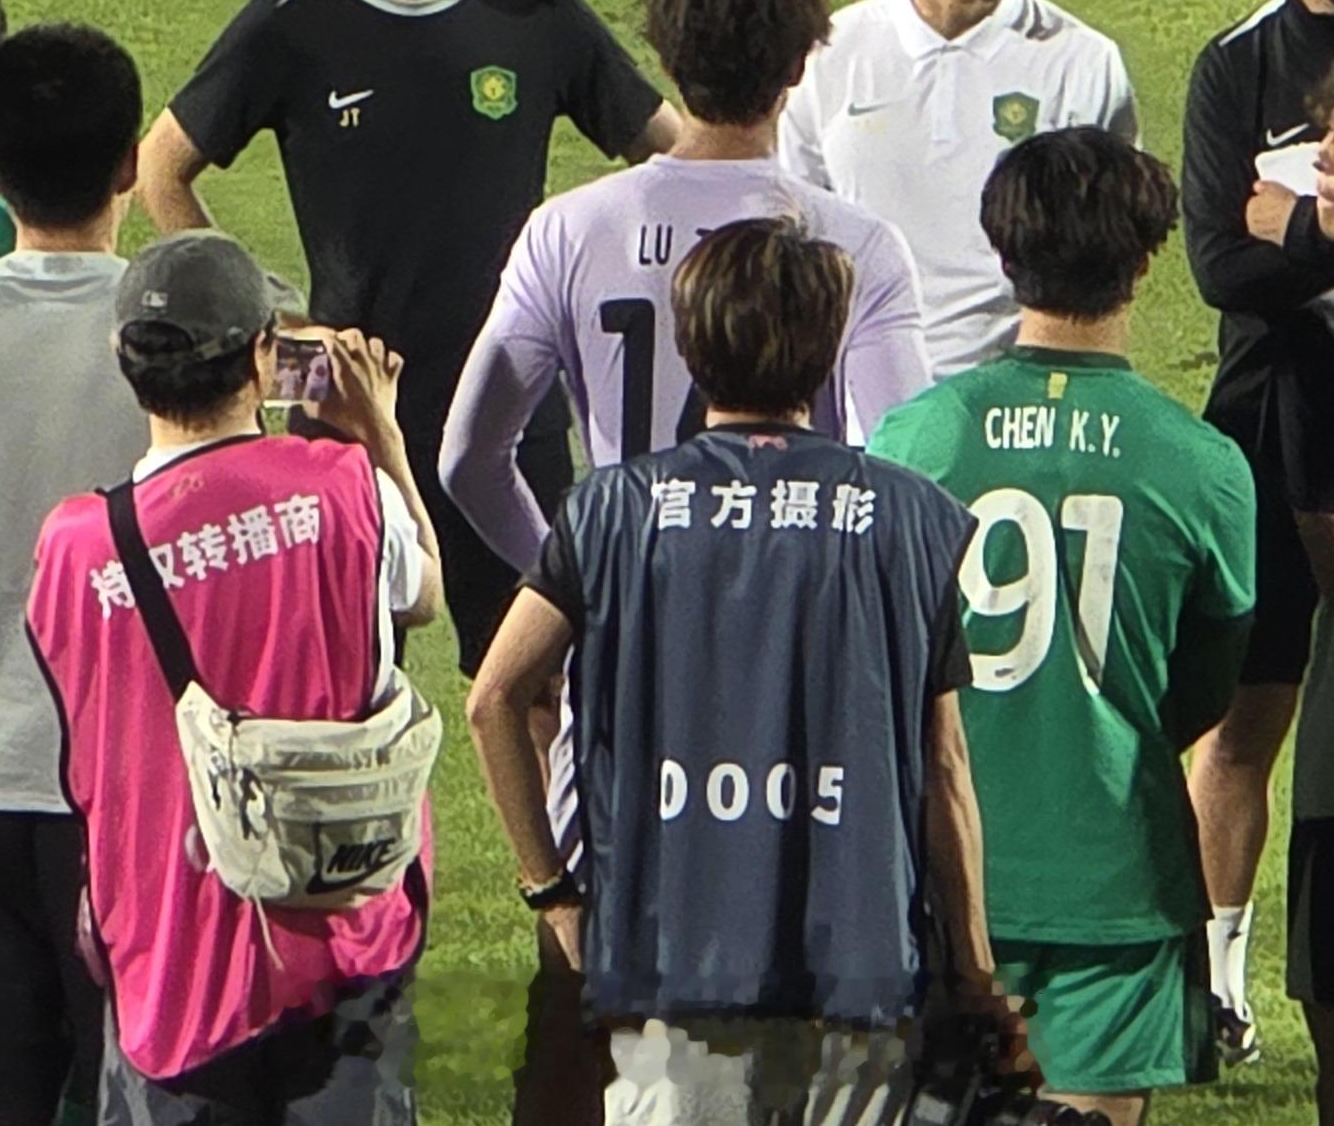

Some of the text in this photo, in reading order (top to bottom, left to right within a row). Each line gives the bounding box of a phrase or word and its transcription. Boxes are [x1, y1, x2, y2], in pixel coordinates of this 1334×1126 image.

[340, 107, 360, 127] JT
[639, 224, 672, 266] LU
[984, 406, 1056, 450] CHEN
[651, 478, 876, 535] 官方摄影
[958, 488, 1124, 695] 91
[660, 759, 844, 826] 0005
[327, 838, 397, 874] NIKE
